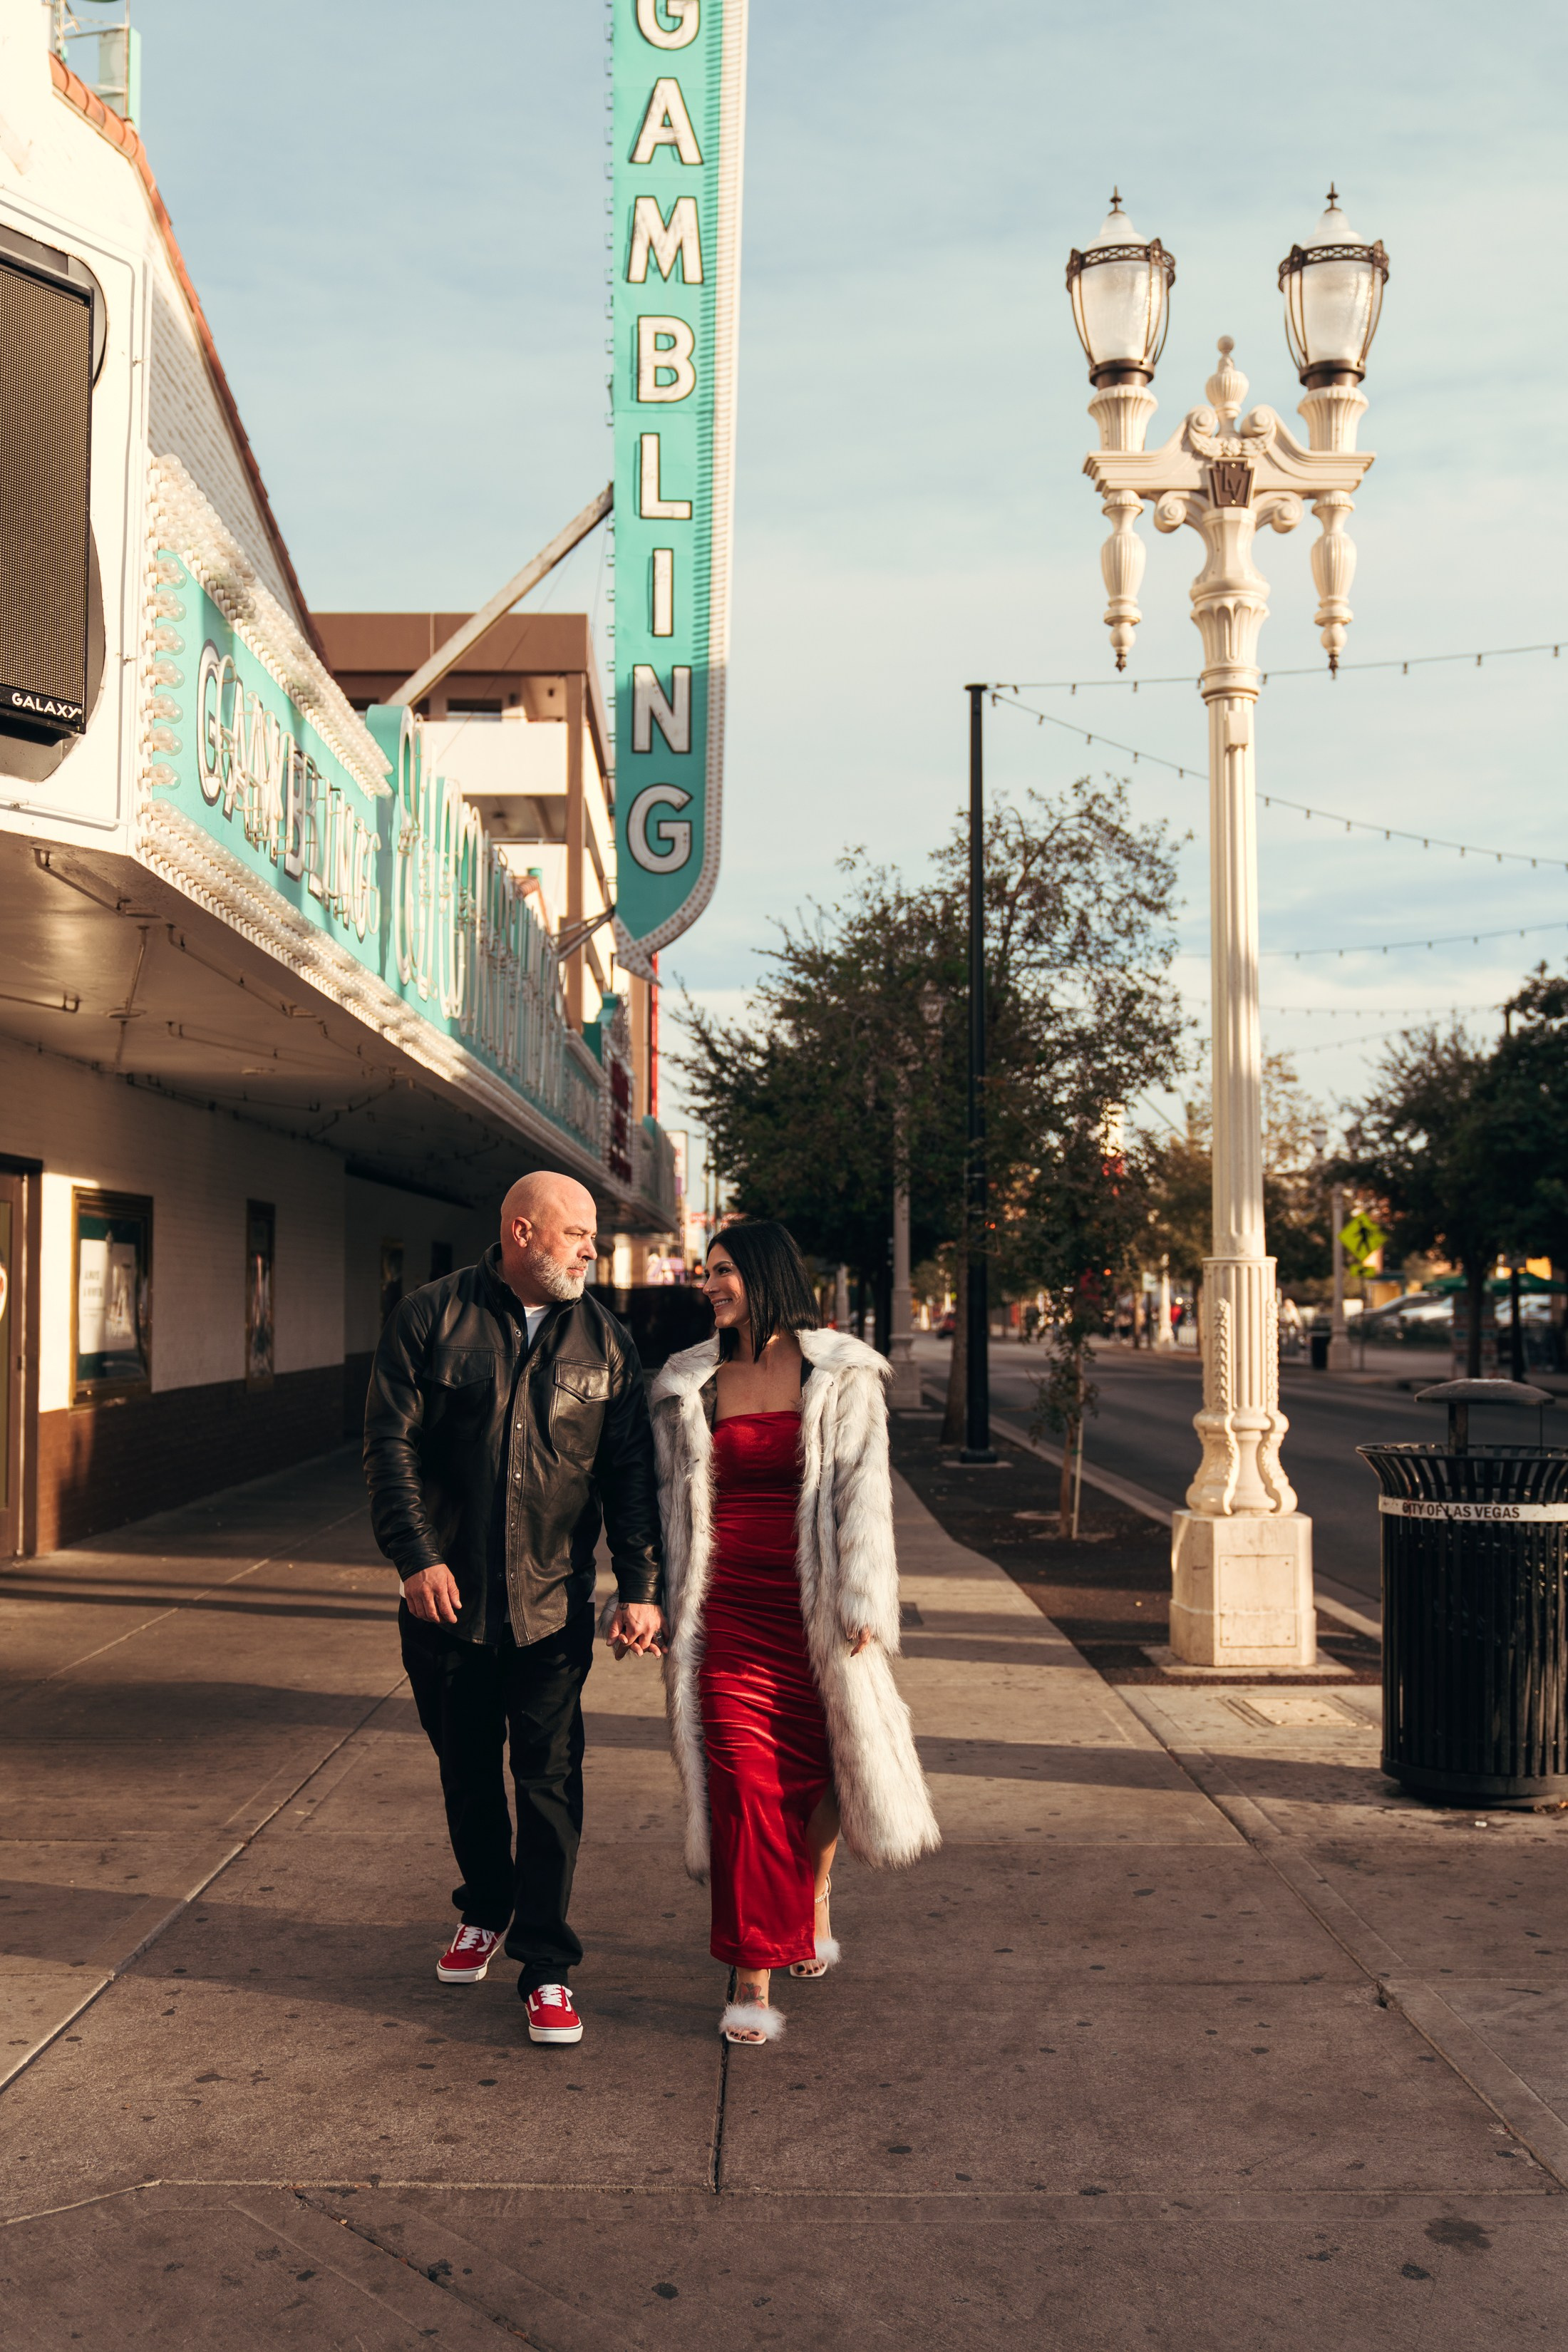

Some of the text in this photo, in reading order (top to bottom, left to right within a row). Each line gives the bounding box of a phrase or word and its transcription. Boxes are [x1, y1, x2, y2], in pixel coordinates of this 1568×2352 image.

[627, 0, 705, 873] GAMBLING
[11, 692, 78, 719] GALAXY
[197, 639, 381, 944] GAMBLING
[1402, 1502, 1520, 1519] CITY OF LAS VEGAS
